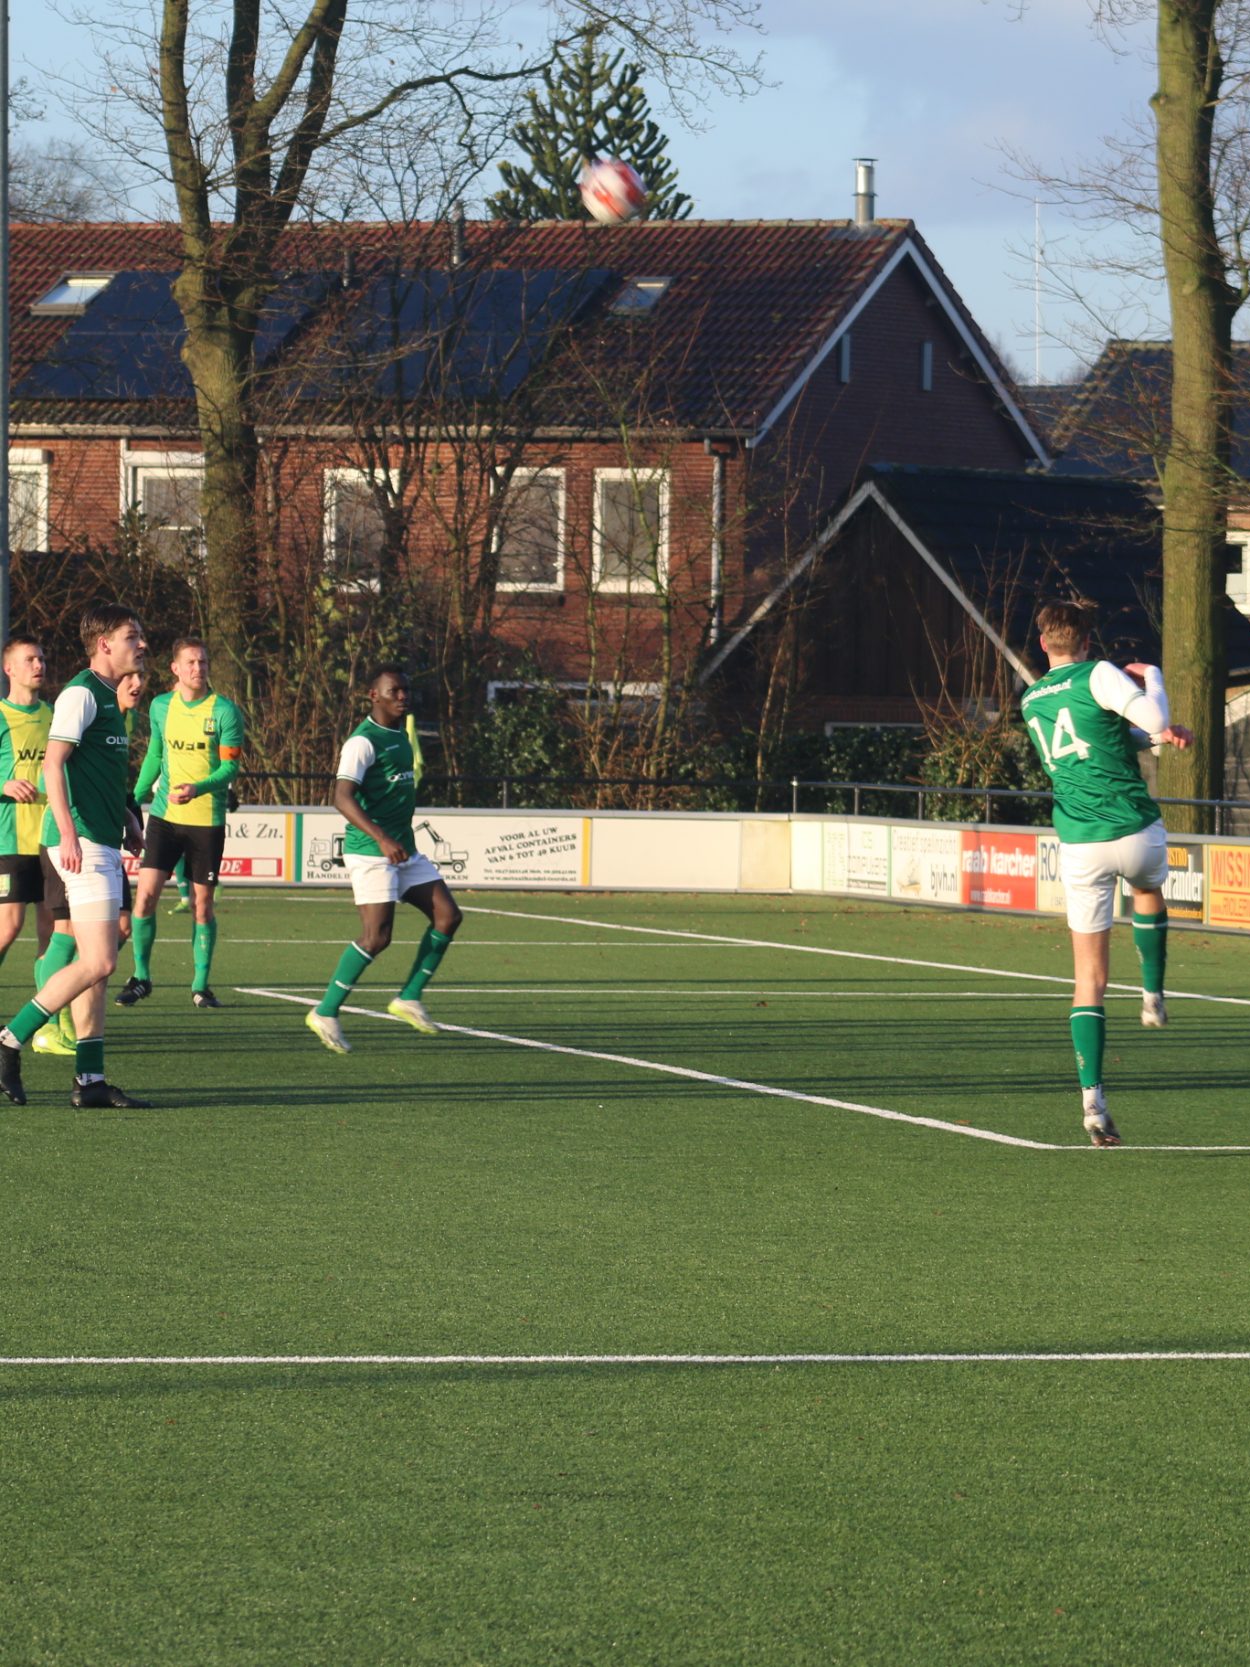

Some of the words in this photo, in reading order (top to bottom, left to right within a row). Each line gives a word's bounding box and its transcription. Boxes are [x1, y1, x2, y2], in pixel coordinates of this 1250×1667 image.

[1027, 706, 1092, 772] 14
[235, 822, 250, 839] &
[255, 823, 283, 839] Zn.
[499, 832, 527, 842] VOOR
[527, 829, 540, 838] AL
[542, 826, 558, 835] UW
[484, 844, 515, 855] AFVAL
[516, 833, 578, 850] CONTAINERS
[487, 854, 507, 864] VAN
[515, 849, 535, 860] TOT
[549, 843, 577, 855] KUUB
[961, 845, 987, 874] raab
[989, 845, 1036, 878] karcher
[207, 872, 215, 881] 2
[306, 871, 342, 880] HANDEL
